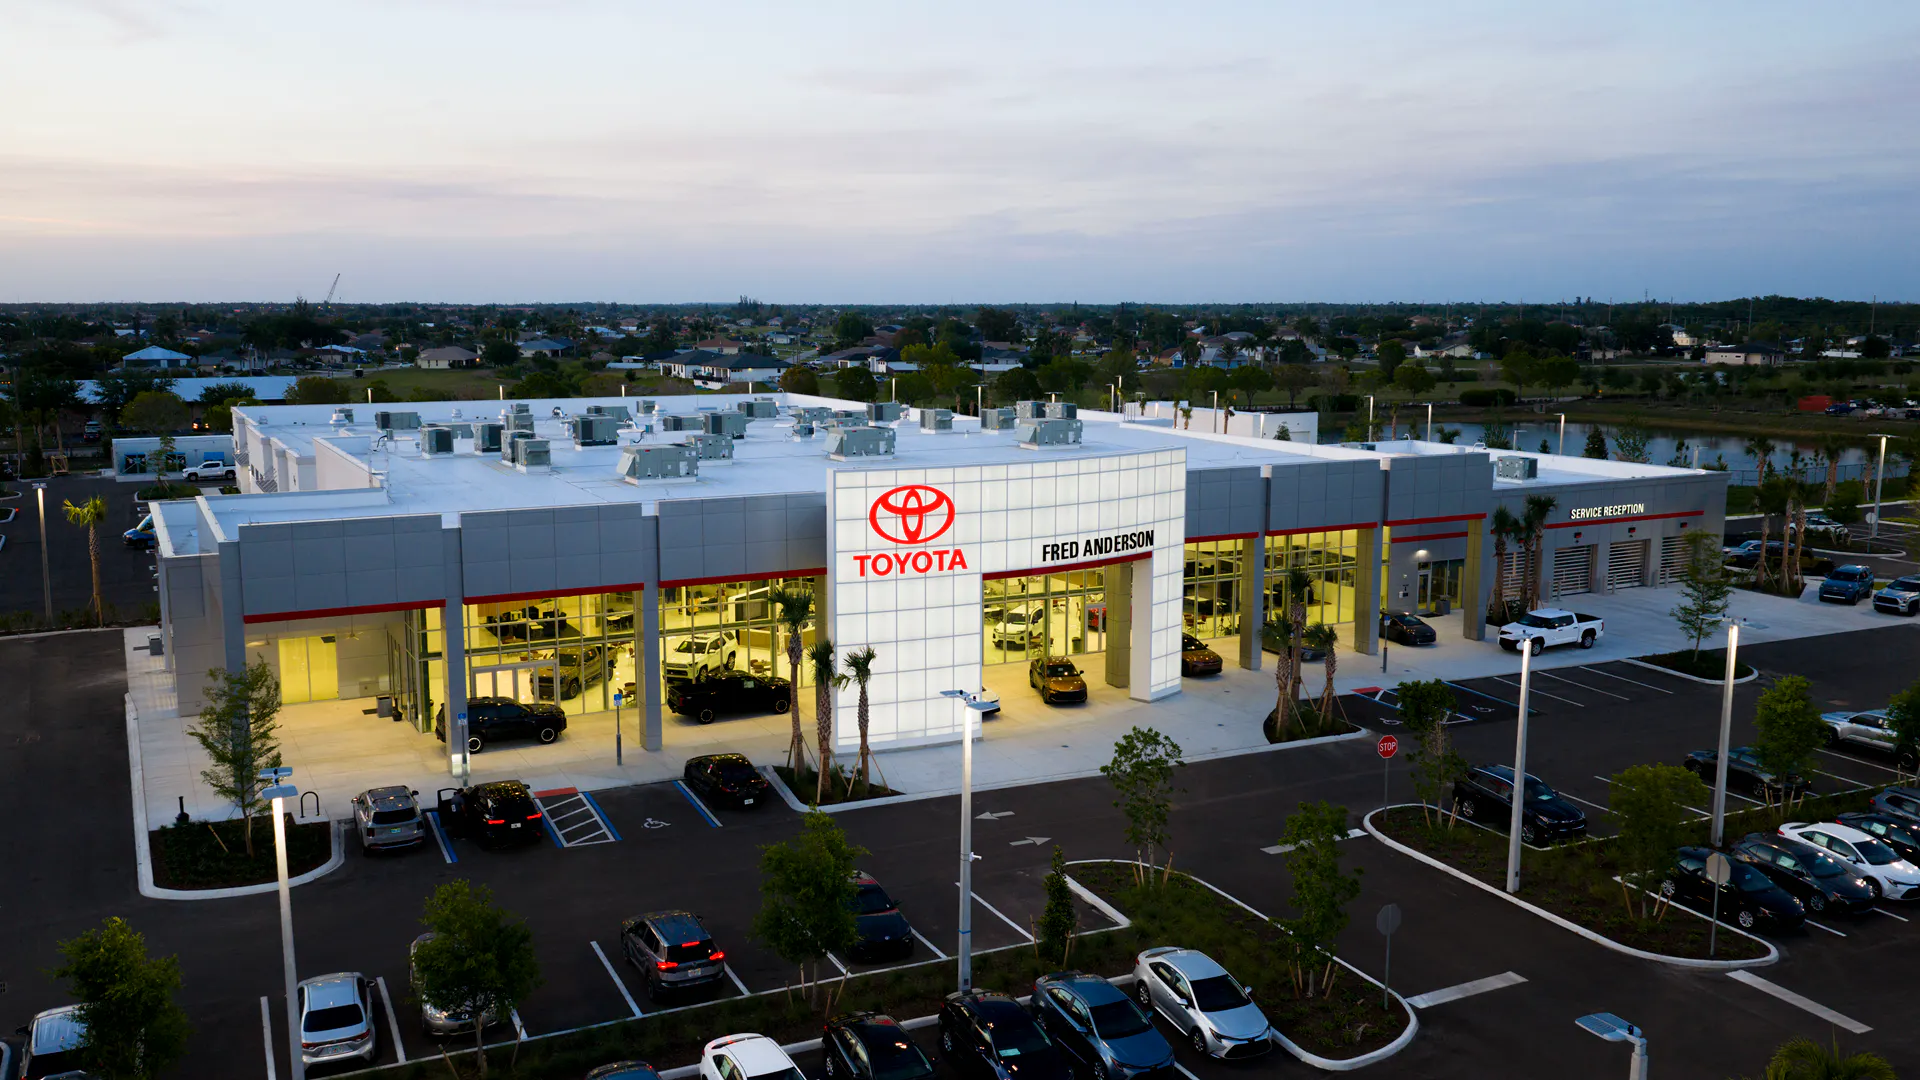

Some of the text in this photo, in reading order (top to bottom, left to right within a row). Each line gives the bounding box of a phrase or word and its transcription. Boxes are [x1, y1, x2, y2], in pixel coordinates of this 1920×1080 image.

[1571, 503, 1645, 520] SERVICE RECEPTION
[1042, 530, 1155, 562] FRED ANDERSON
[853, 549, 968, 577] TOYOTA
[1379, 741, 1396, 752] STOP
